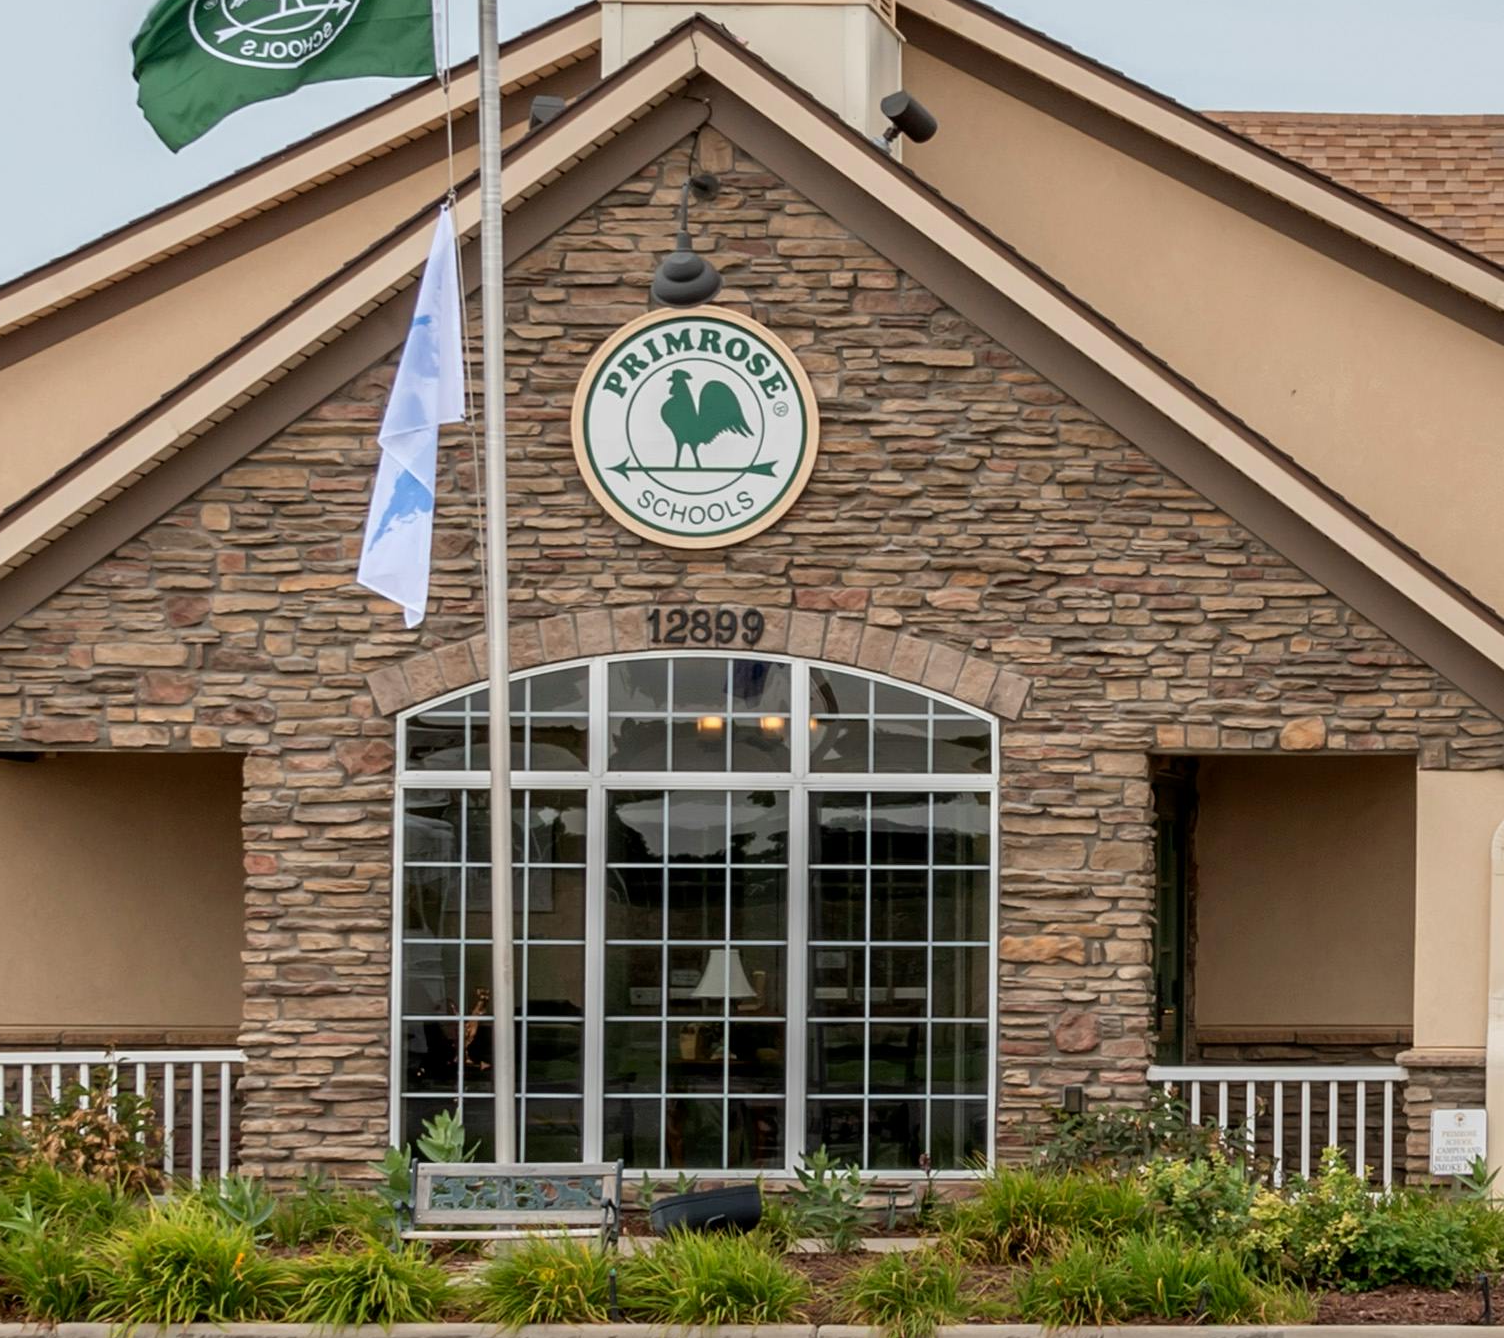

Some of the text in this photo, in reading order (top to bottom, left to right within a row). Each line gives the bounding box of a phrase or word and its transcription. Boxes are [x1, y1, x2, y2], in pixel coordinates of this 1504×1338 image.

[602, 327, 789, 400] PRIMROSE
[637, 490, 755, 525] SCHOOLS
[647, 608, 764, 645] 12899
